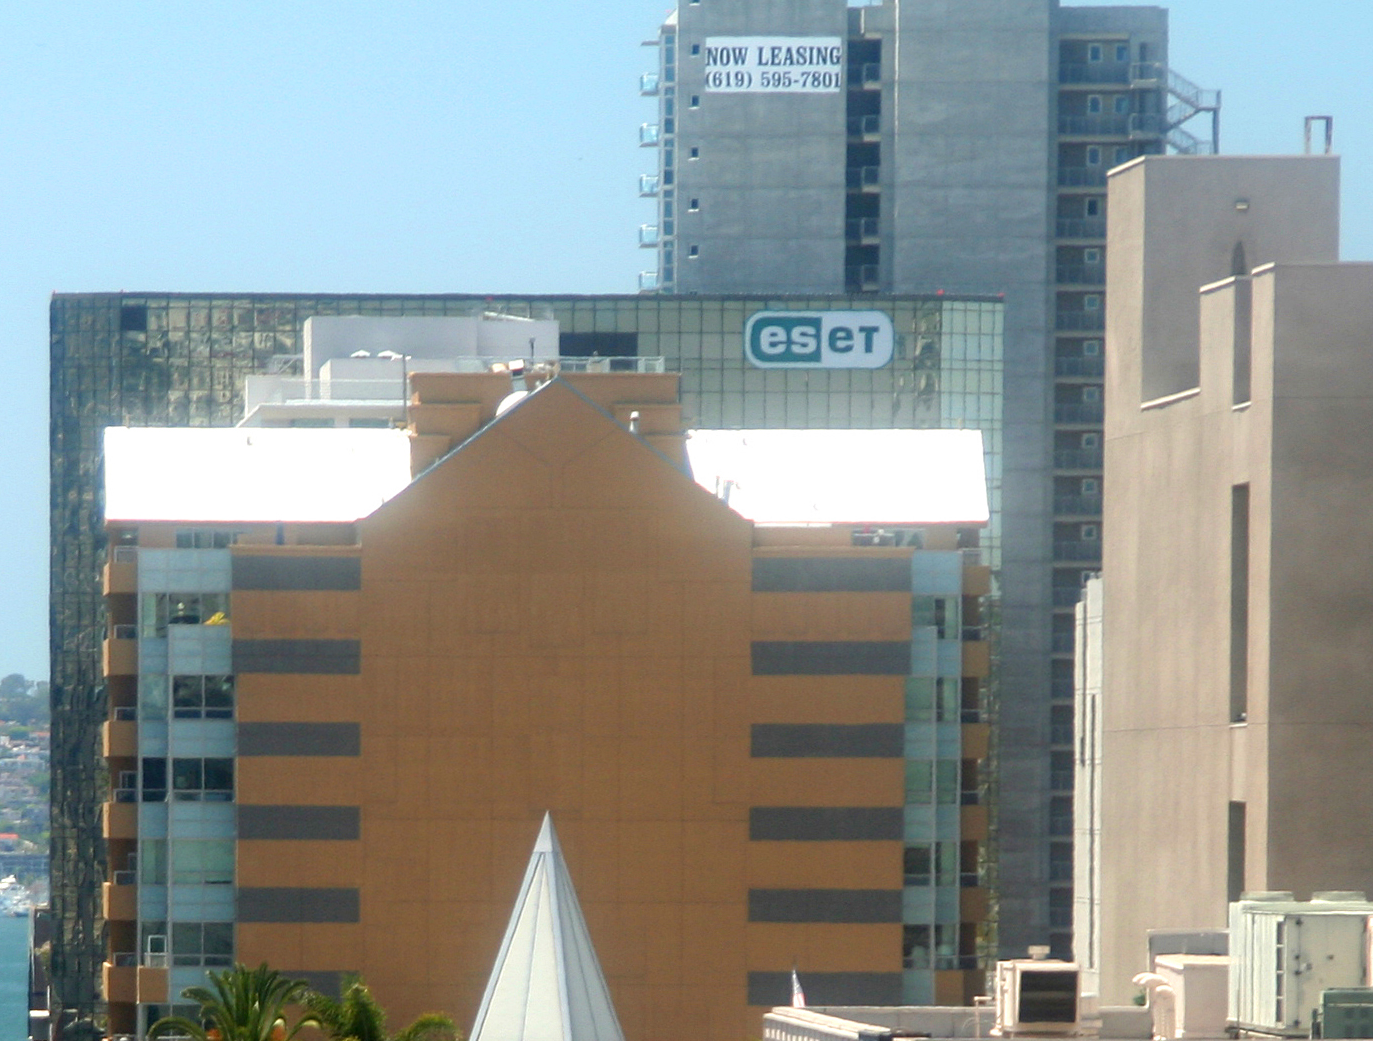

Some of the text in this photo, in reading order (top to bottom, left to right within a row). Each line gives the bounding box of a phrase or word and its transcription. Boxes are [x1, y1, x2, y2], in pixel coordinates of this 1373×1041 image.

[705, 46, 841, 66] NOW LEASING
[705, 71, 841, 88] (619) 595-7801
